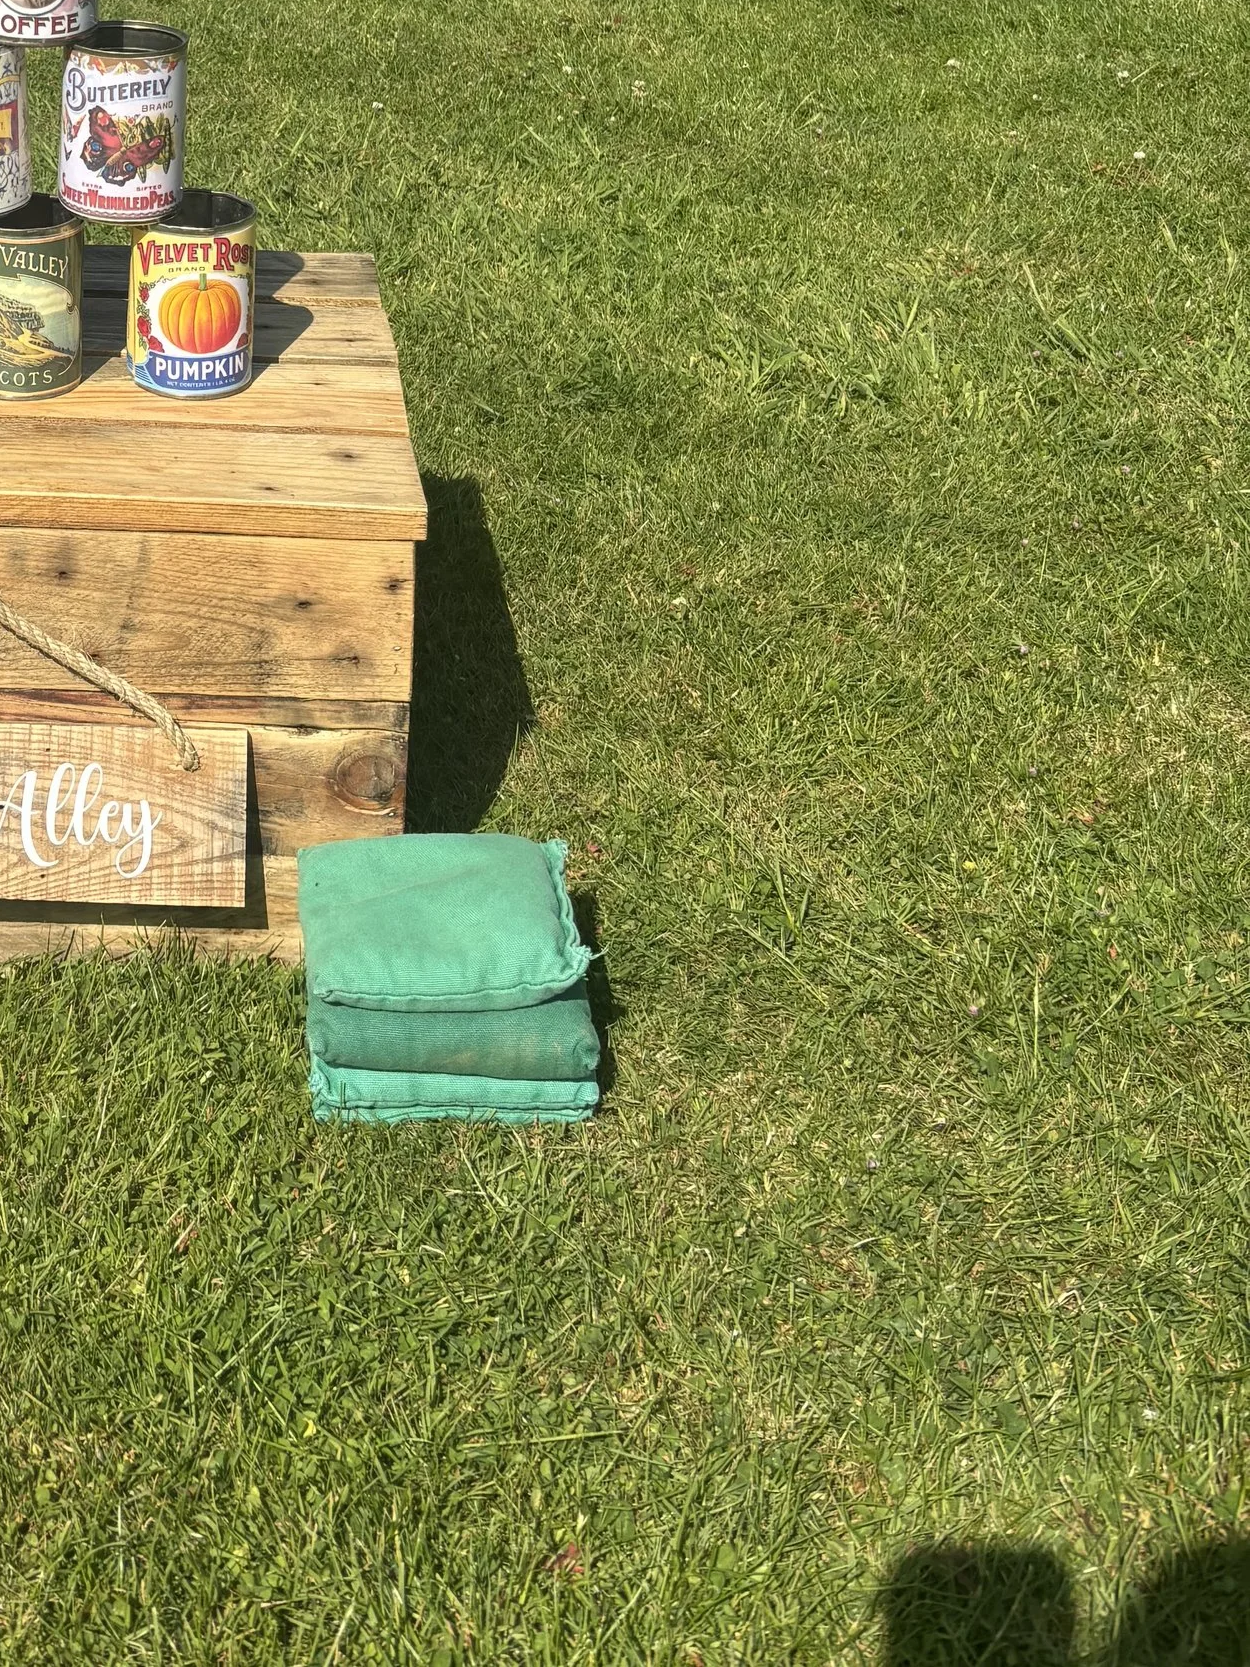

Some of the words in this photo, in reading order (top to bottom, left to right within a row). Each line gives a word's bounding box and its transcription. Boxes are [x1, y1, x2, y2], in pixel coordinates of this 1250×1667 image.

[66, 66, 172, 113] BUTTERFLY
[141, 100, 174, 113] BRAND
[81, 181, 103, 190] EXTRA
[87, 189, 149, 211] WRINKLED
[137, 240, 212, 276] VELVET
[154, 351, 245, 381] PUMPKIN
